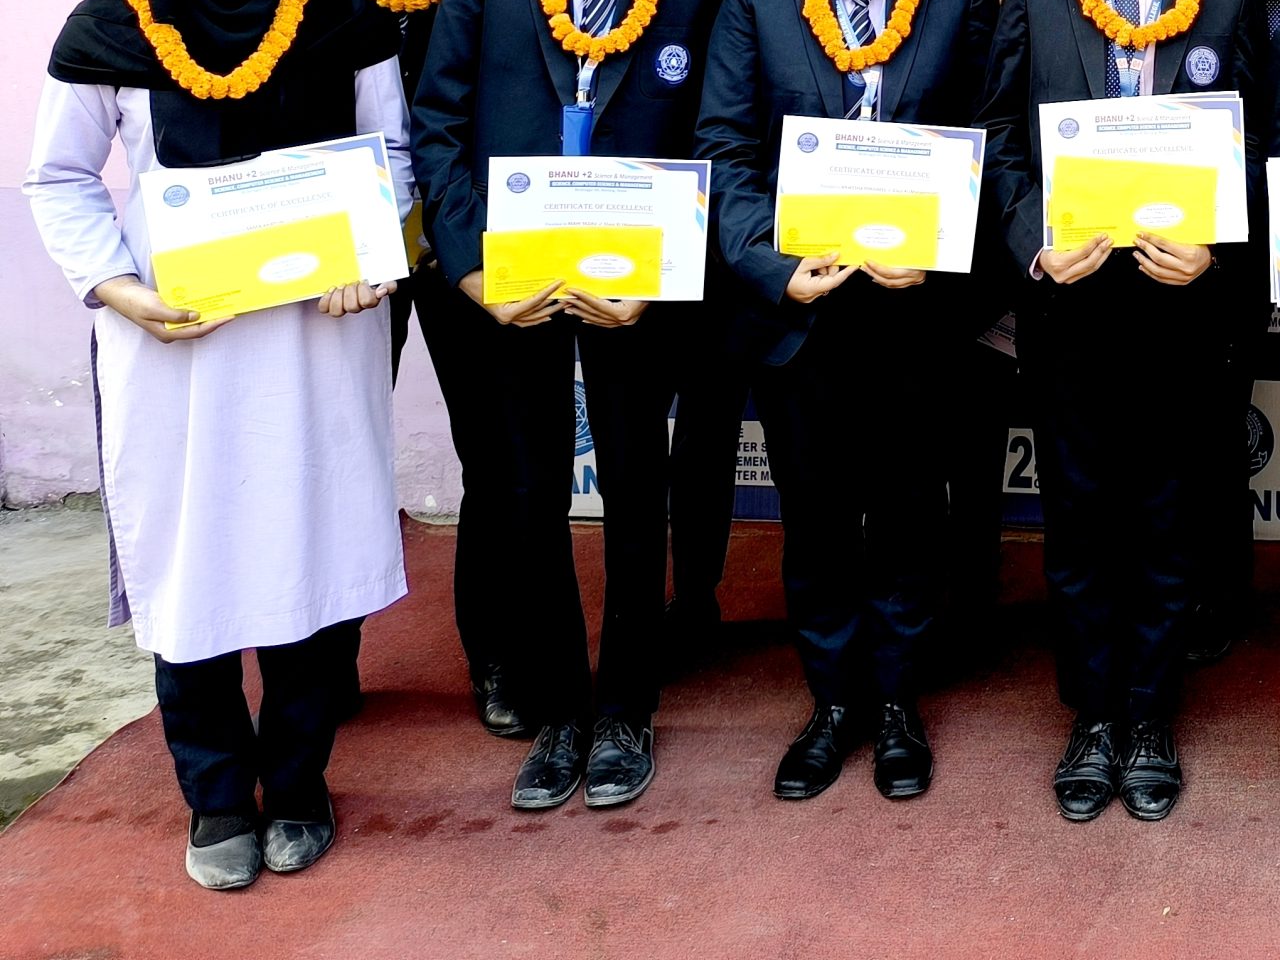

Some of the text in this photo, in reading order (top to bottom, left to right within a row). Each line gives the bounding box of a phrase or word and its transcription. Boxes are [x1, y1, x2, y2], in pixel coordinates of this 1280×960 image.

[1095, 115, 1123, 123] BHANU
[835, 134, 864, 142] BHANU
[208, 171, 243, 186] BHANU
[1008, 436, 1033, 489] 2
